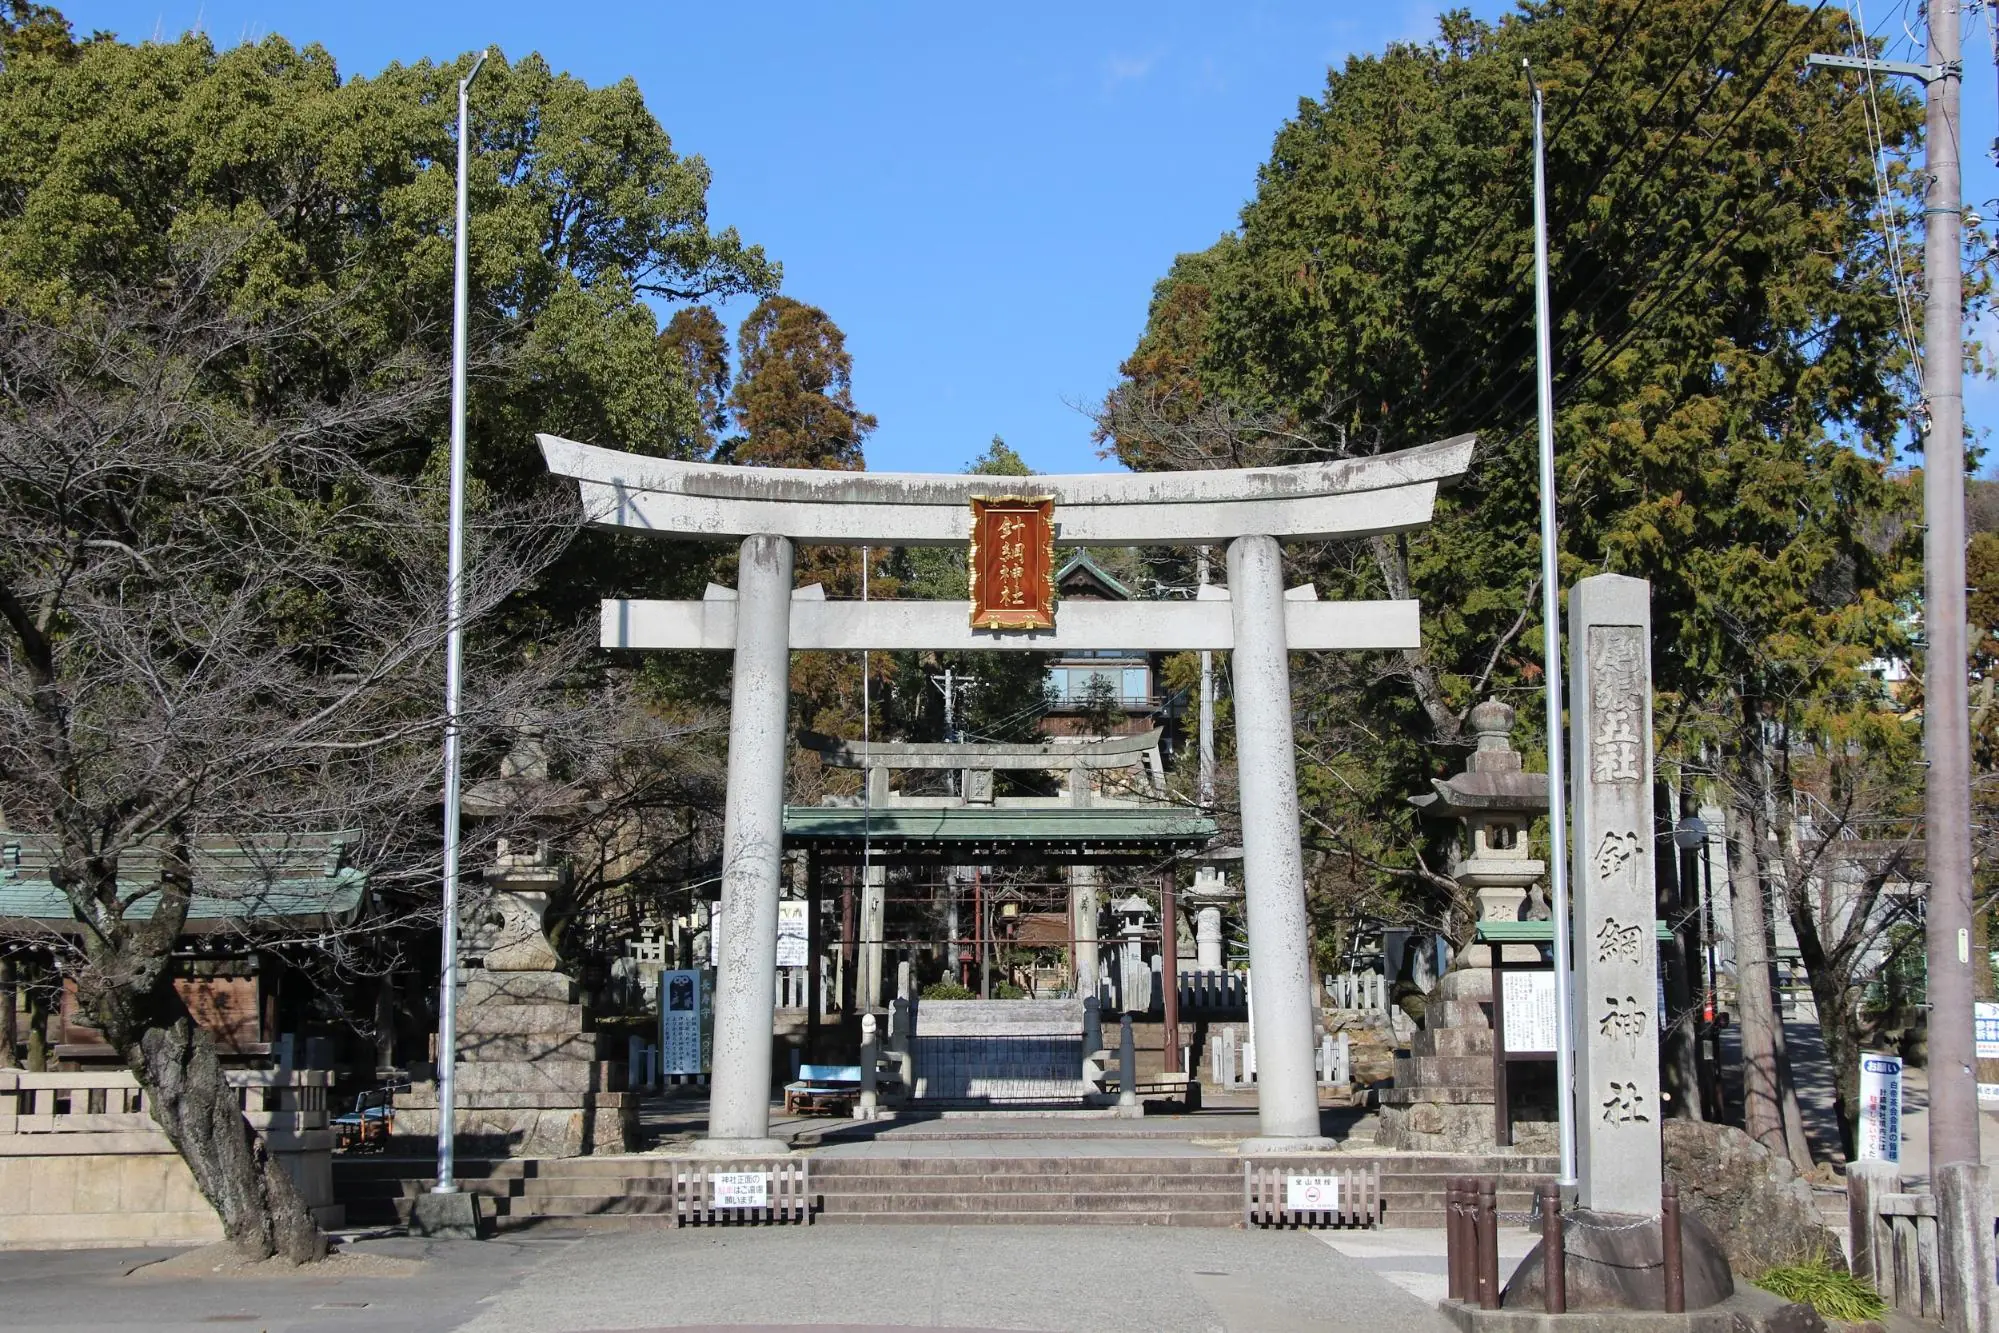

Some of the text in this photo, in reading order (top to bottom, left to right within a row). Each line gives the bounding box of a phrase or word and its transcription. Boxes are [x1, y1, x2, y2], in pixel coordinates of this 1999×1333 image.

[998, 515, 1026, 607] 針綱神社
[1594, 831, 1650, 1129] 針綱神社
[1867, 1060, 1898, 1073] お願い
[721, 1175, 760, 1184] 神社正面の
